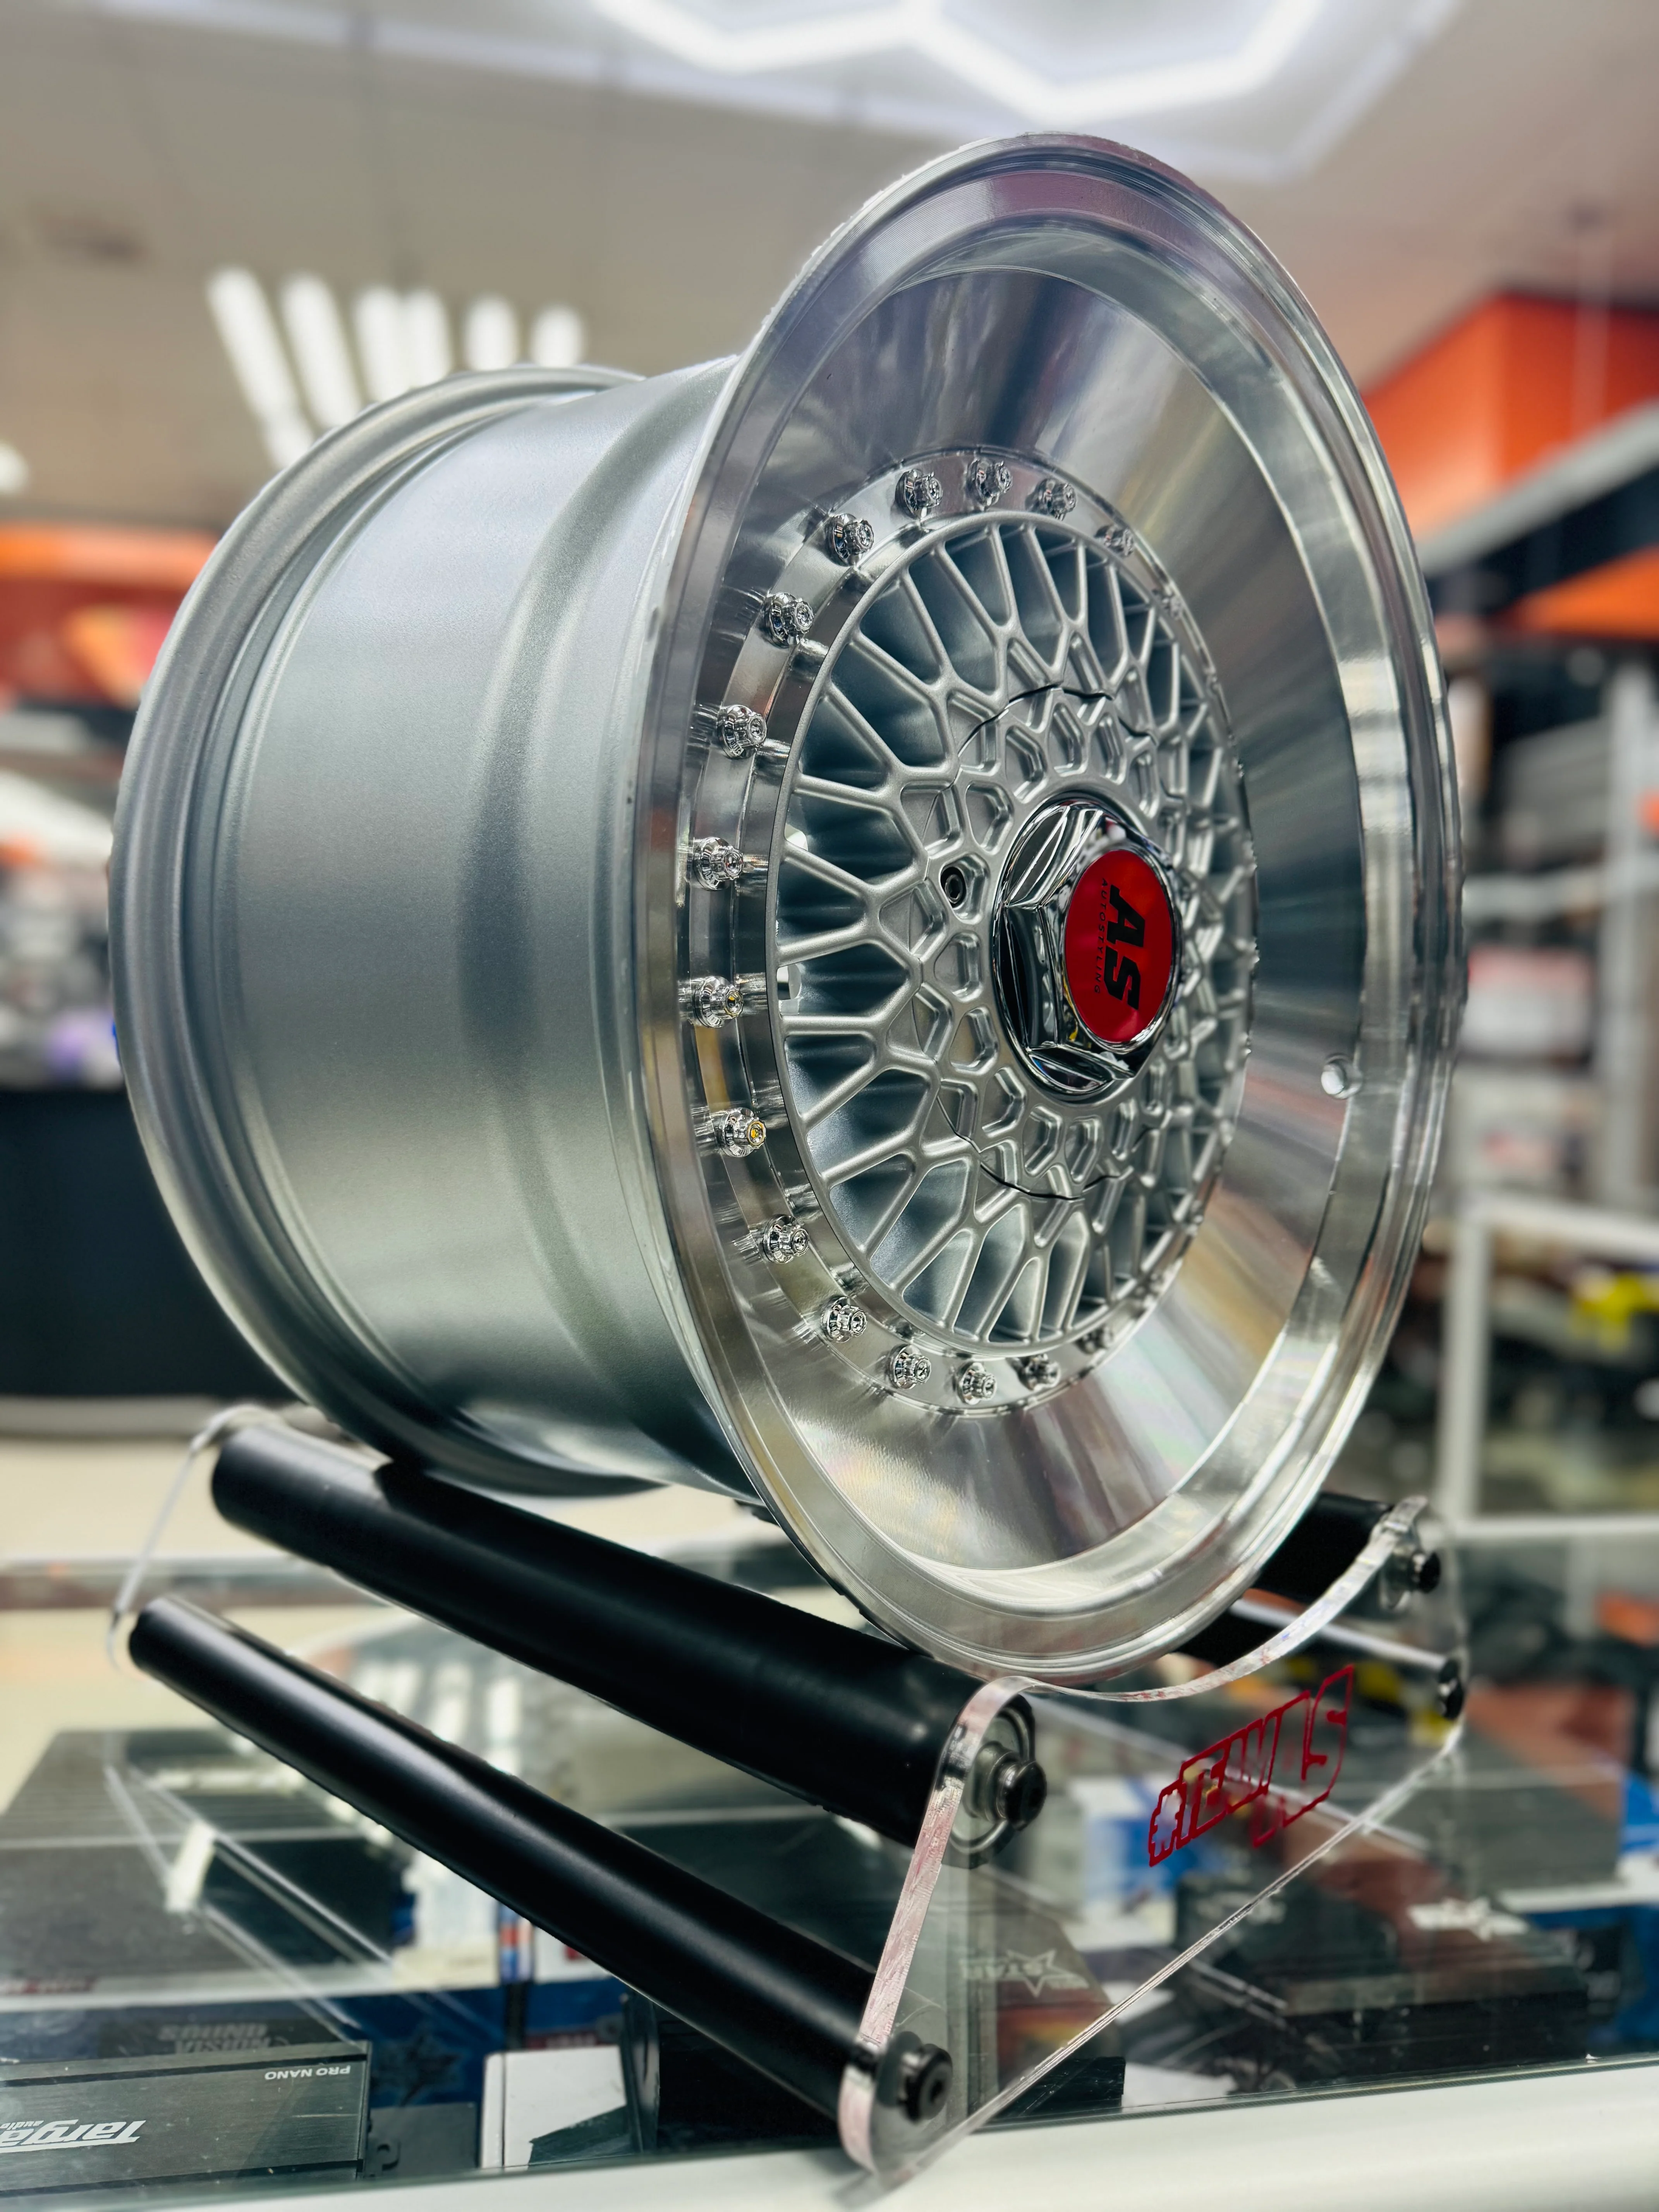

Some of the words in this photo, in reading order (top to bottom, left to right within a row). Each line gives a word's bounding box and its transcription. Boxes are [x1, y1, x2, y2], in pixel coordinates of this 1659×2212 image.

[1094, 877, 1108, 994] AUTOSTYLING
[1103, 884, 1146, 1010] AS
[264, 2068, 312, 2080] NANO
[316, 2065, 350, 2076] PRO
